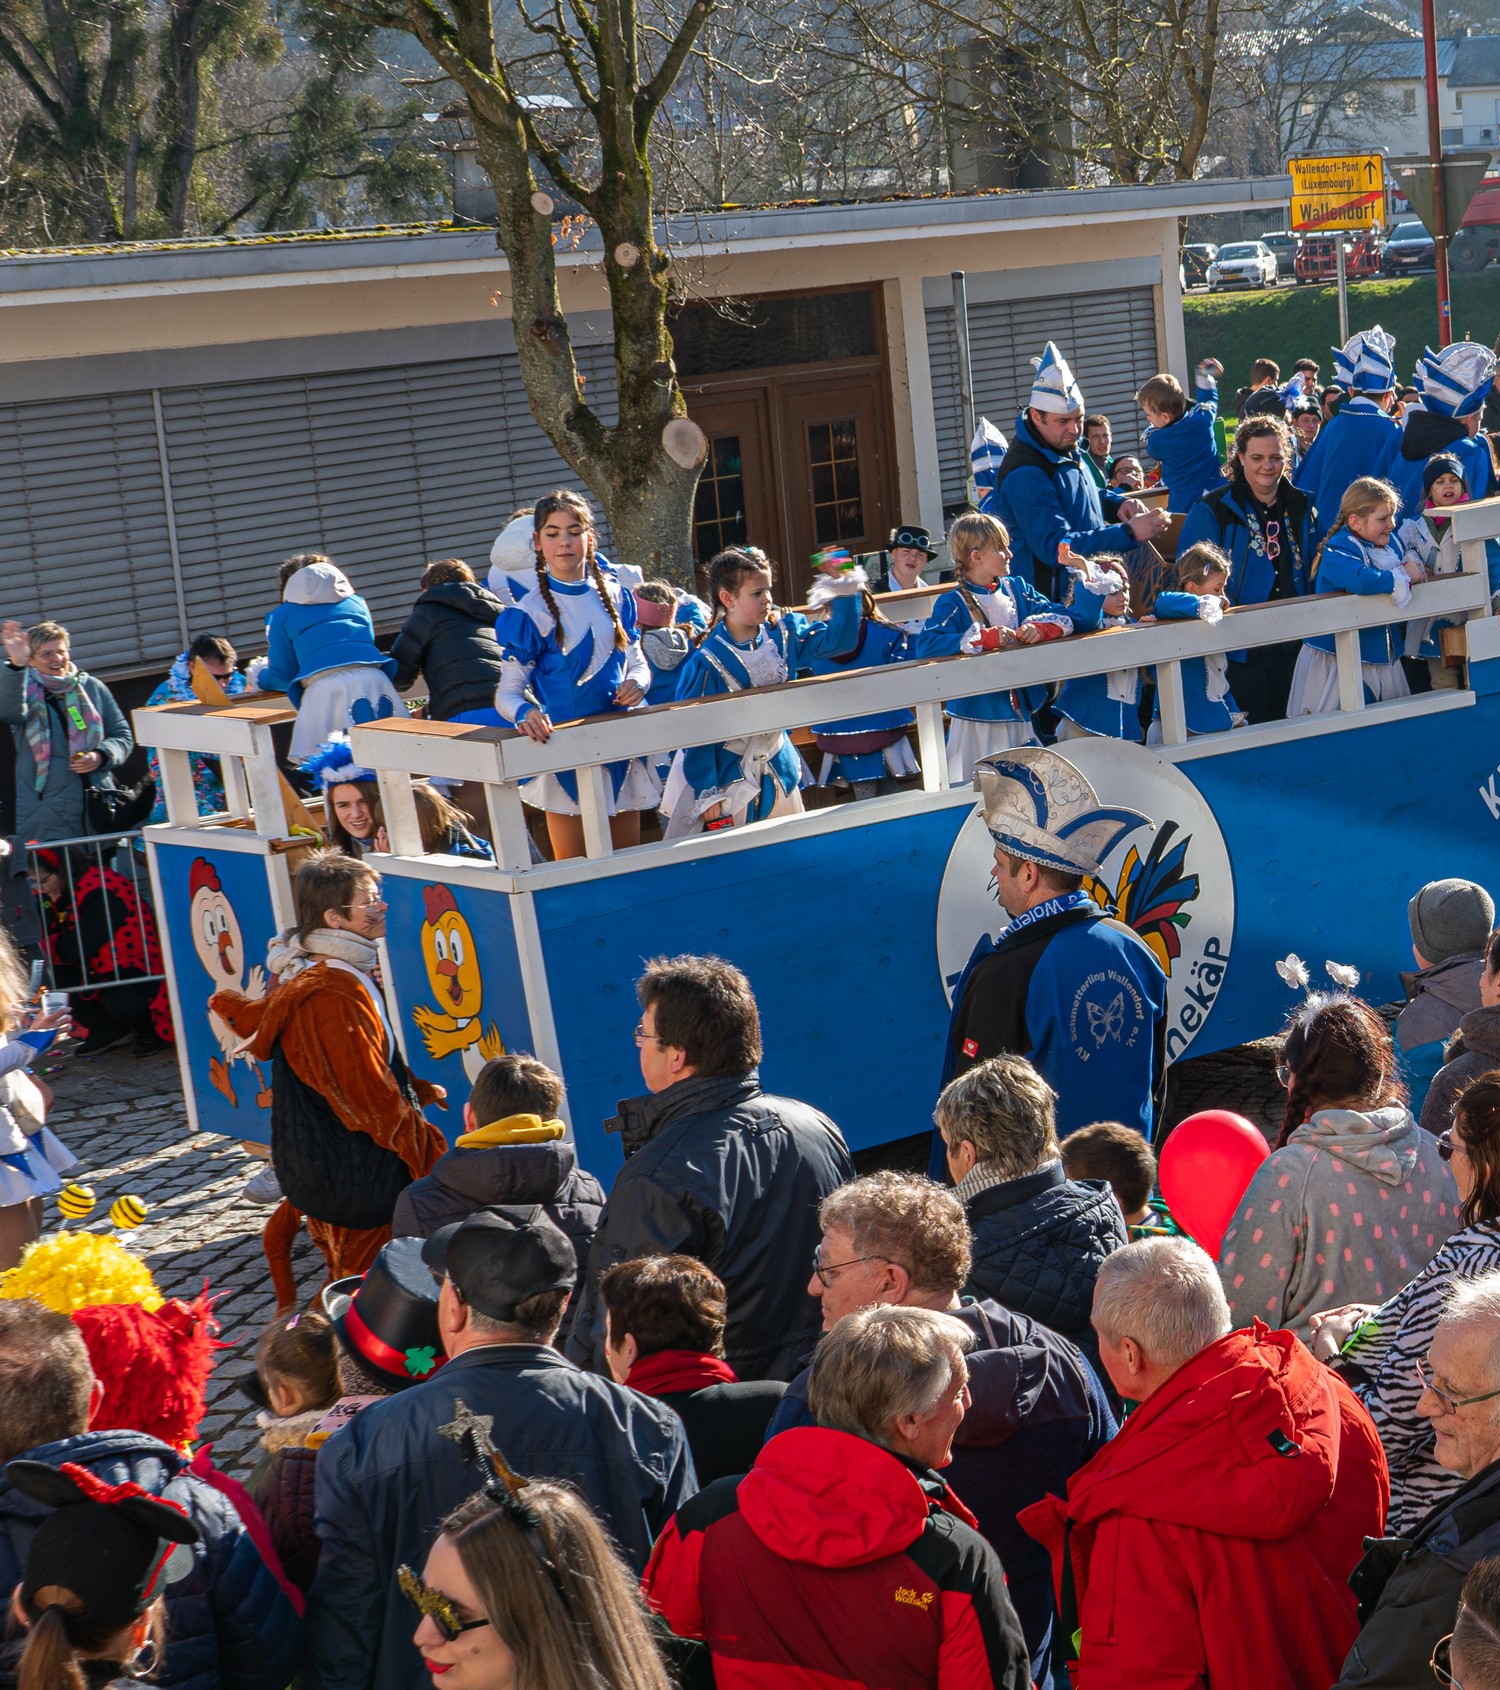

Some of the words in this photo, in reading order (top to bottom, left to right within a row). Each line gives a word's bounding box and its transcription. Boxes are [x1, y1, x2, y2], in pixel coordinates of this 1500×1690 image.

[1295, 161, 1360, 175] Wallendorf-Pont
[1301, 176, 1354, 191] (Luxembourg)
[1300, 200, 1376, 223] Wallendorf
[1075, 1046, 1091, 1062] KV
[1107, 969, 1145, 1020] Wallendorf
[896, 1586, 917, 1598] Jack
[894, 1592, 929, 1611] Wolfskin
